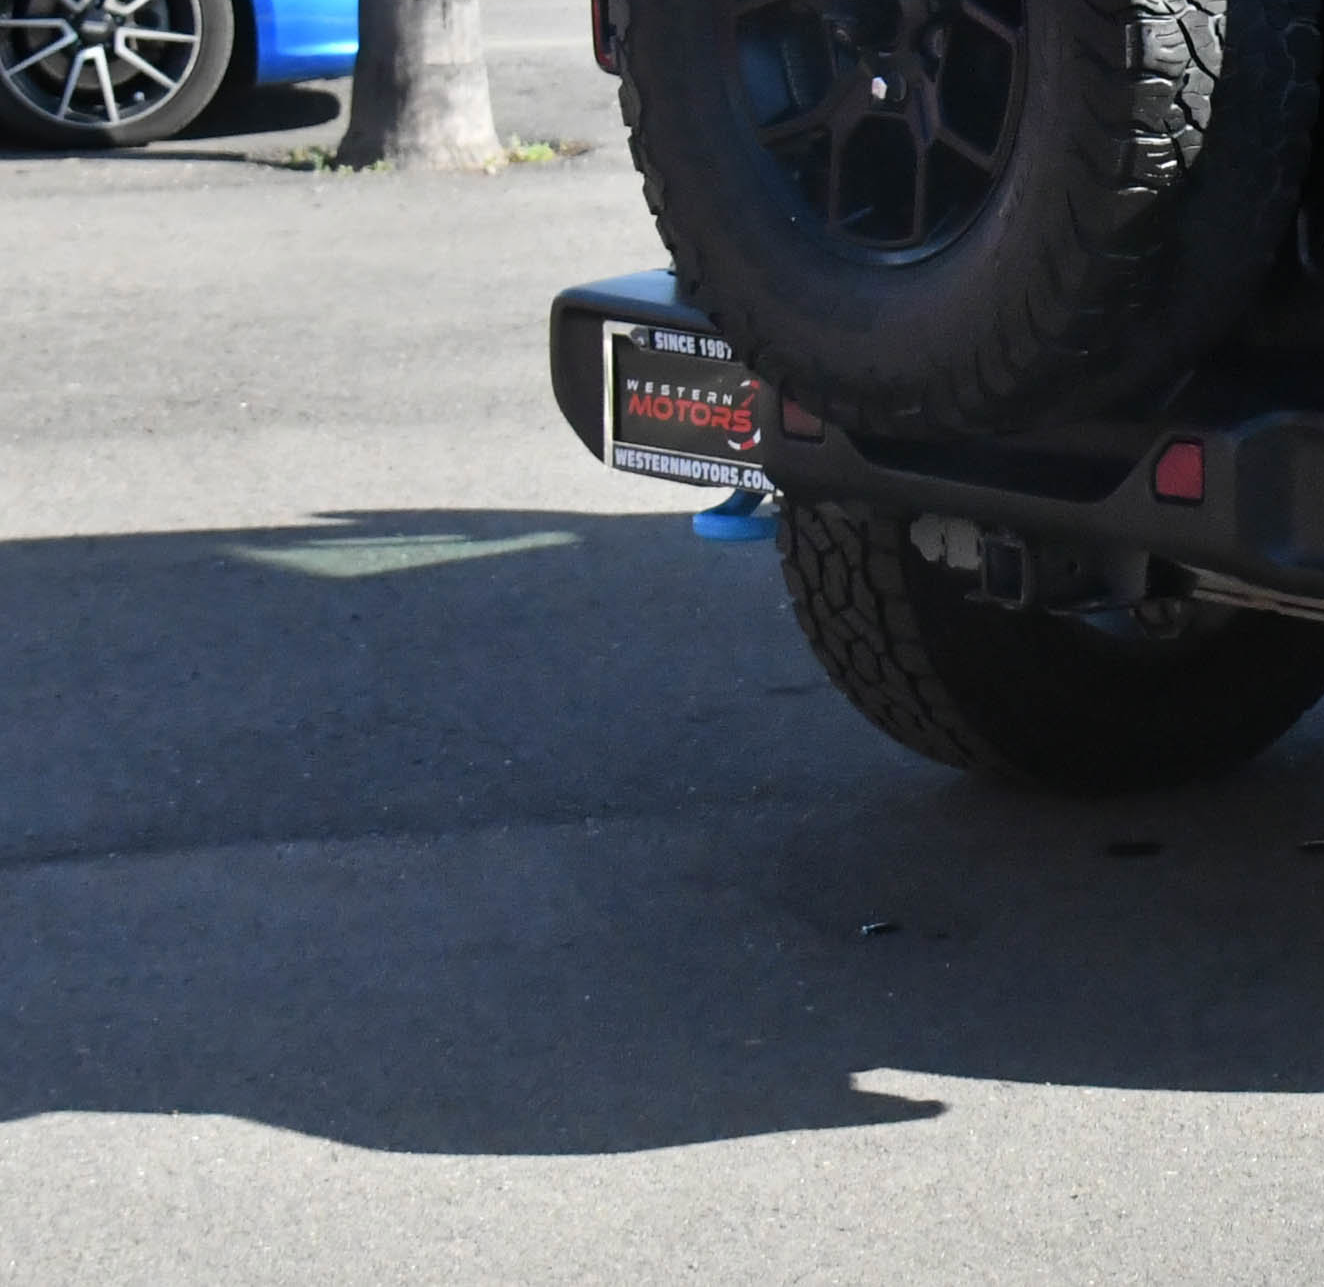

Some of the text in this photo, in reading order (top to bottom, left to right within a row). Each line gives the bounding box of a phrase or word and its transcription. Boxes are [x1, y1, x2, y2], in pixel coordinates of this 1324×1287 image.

[654, 331, 696, 355] SINCE
[626, 378, 733, 406] WESTERN
[628, 393, 753, 434] MOTORS
